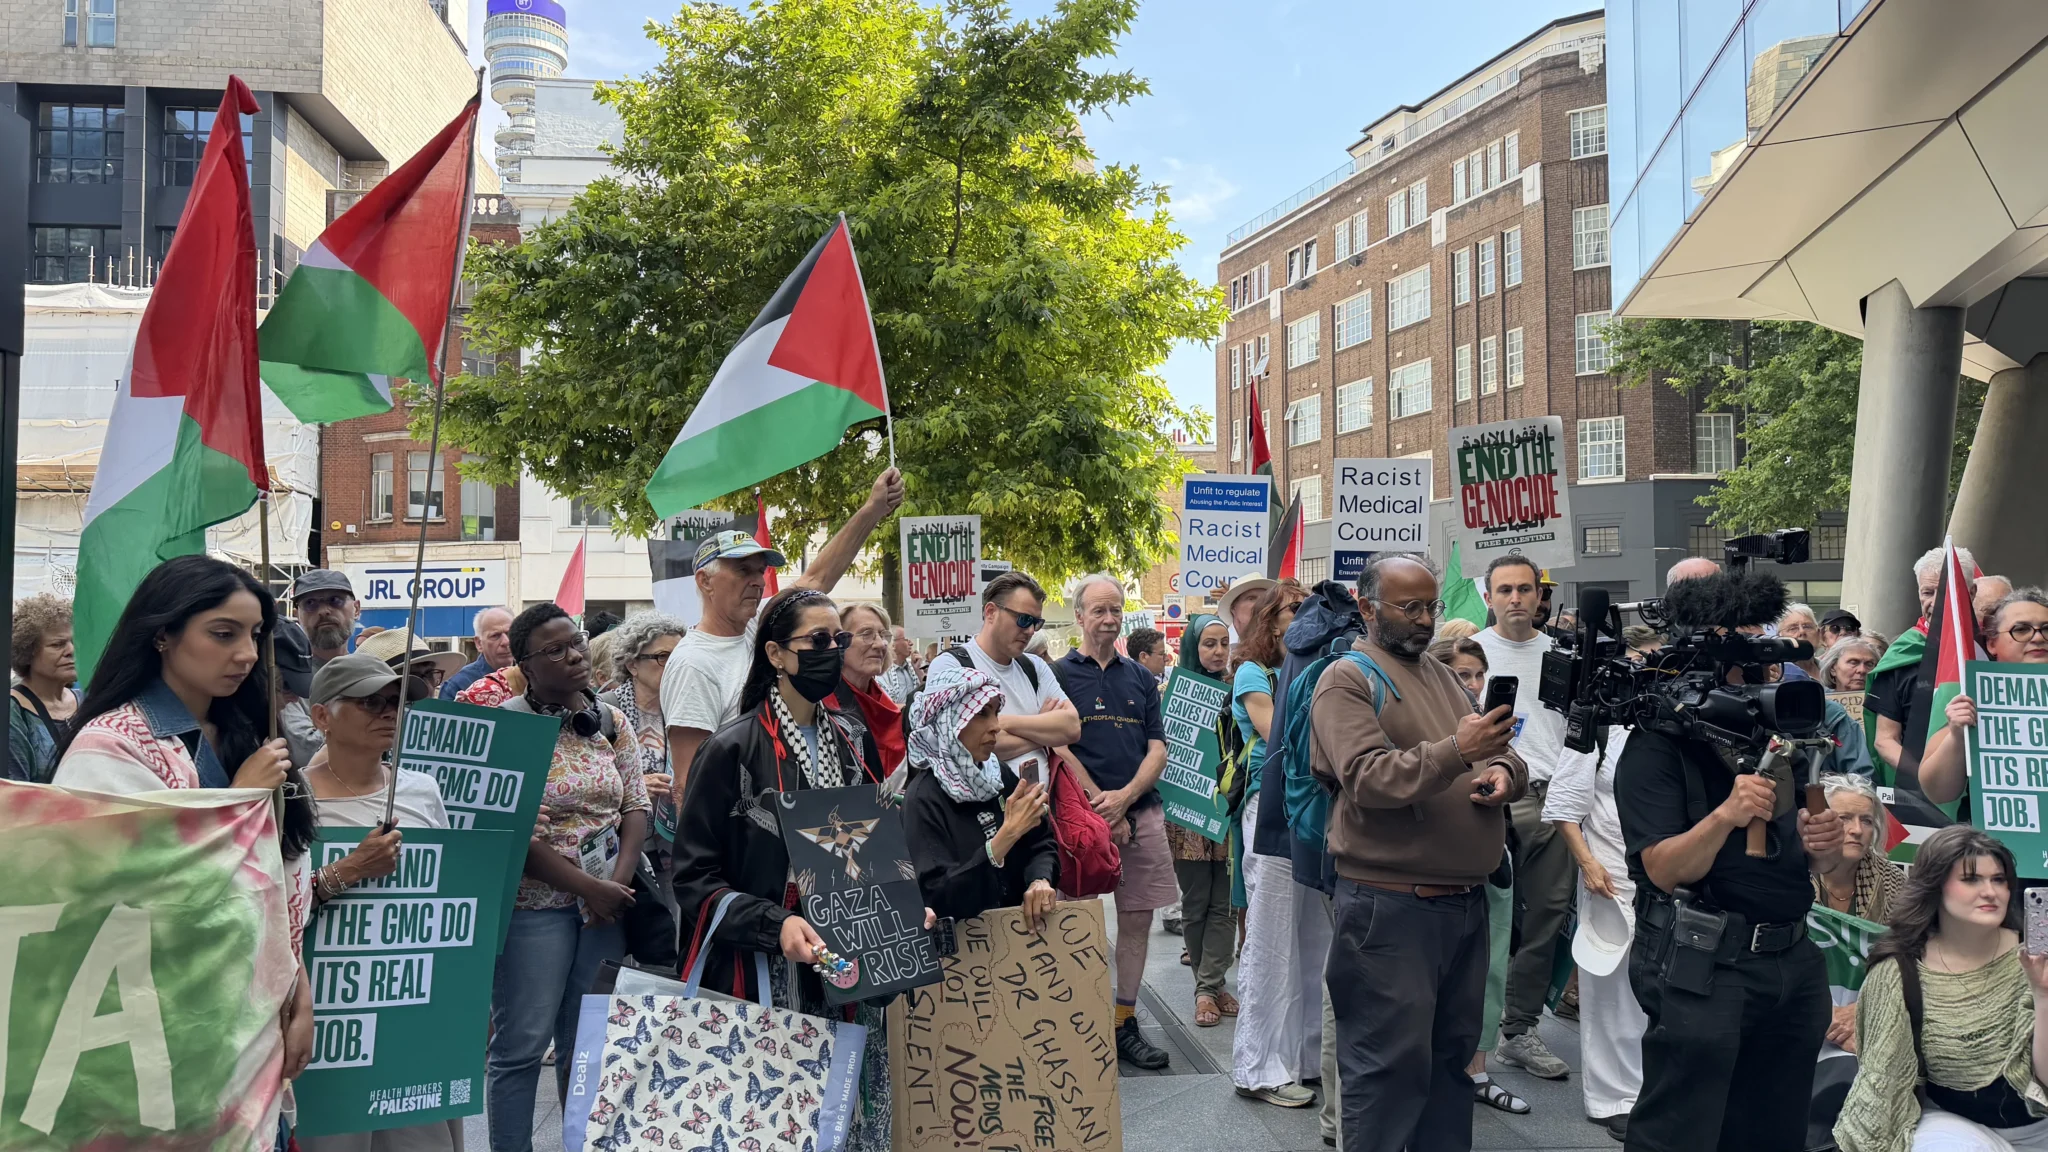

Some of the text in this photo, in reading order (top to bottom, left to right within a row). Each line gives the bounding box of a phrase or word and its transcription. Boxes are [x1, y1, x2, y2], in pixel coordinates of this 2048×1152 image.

[1341, 466, 1422, 486] Racist
[1457, 435, 1558, 486] END THE
[1193, 486, 1261, 498] Unfit to regulate
[1339, 494, 1423, 514] Medical
[1461, 473, 1562, 530] GENOCIDE
[1189, 518, 1261, 538] Racist
[1338, 522, 1422, 542] Council
[1477, 534, 1553, 549] FREE PALESTINE
[907, 531, 976, 563] END THE
[1187, 544, 1262, 564] Medical
[1342, 556, 1364, 565] Unfit
[908, 560, 977, 599] GENOCIDE
[988, 563, 1010, 571] Campaign
[1185, 570, 1238, 588] Coun
[364, 577, 486, 600] JRL GROUP
[1175, 676, 1225, 708] DR GHASS
[1083, 714, 1116, 722] ETHIOPIAN
[1168, 697, 1218, 729] SAVES LIV
[405, 714, 490, 757] DEMAND
[1164, 717, 1194, 744] LIMBS.
[1980, 715, 2022, 747] THE
[436, 765, 482, 804] GMC
[483, 771, 518, 808] DO
[1163, 765, 1211, 797] GHASSAN.
[1983, 755, 2019, 787] ITS
[1171, 808, 1206, 828] PALESTINE
[1986, 796, 2036, 829] JOB.
[807, 884, 892, 927] GAZA
[323, 901, 472, 946] THE GMC DO
[832, 910, 919, 953] WILL
[1059, 914, 1108, 971] WE
[862, 935, 939, 986] RISE
[964, 916, 993, 1032] WE WILL
[314, 958, 426, 1005] ITS REAL
[943, 954, 969, 1008] NOT
[1010, 917, 1115, 1081] STAND WITH
[310, 1018, 369, 1064] JOB.
[998, 962, 1108, 1144] DR GHASSAN
[573, 1050, 590, 1096] Dealz
[846, 1051, 858, 1075] FROM
[370, 1082, 443, 1101] HEALTH WORKERS
[841, 1077, 853, 1101] MADE
[1005, 1056, 1027, 1103] THE
[379, 1092, 442, 1116] PALESTINE
[839, 1103, 848, 1112] IS
[944, 1044, 982, 1149] NOW!
[978, 1063, 1004, 1135] MEDICS
[834, 1114, 845, 1132] BAG
[1028, 1094, 1057, 1150] FREE
